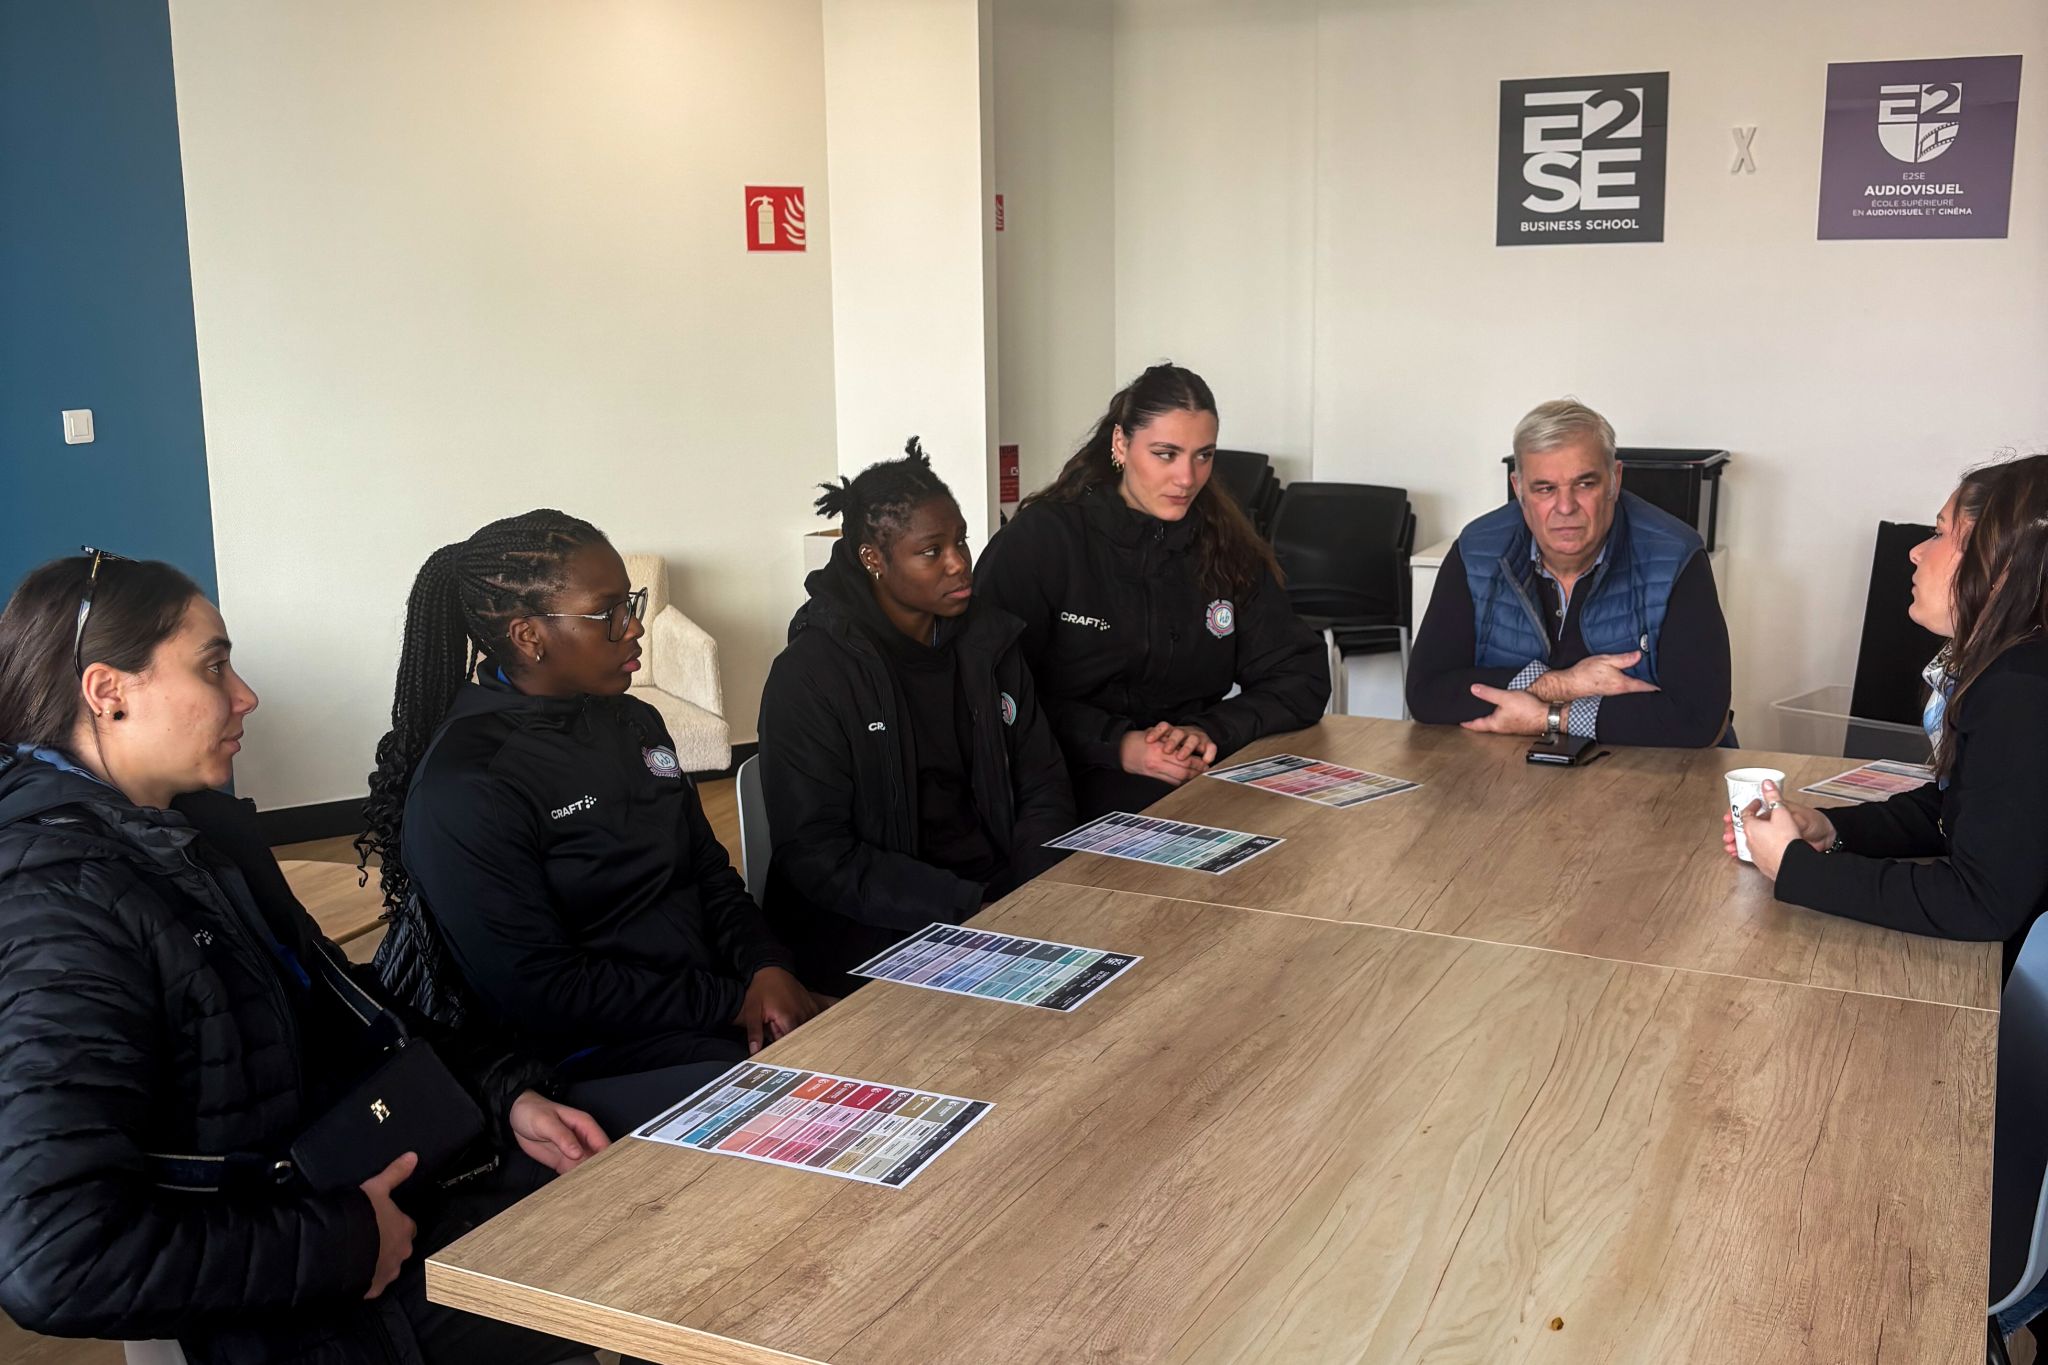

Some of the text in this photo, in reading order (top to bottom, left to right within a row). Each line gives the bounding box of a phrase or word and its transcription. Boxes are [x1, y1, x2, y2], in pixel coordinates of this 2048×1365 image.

[1730, 126, 1758, 175] X
[1902, 172, 1926, 181] E2SE
[1864, 183, 1964, 196] AUDIOVISUEL
[1871, 198, 1954, 208] ÉCOLE SUPÉRIEURE
[1852, 206, 1973, 217] EN AUDIOVISUEL ET CINÉMA
[1520, 218, 1639, 232] BUSINESS SCHOOL
[1060, 611, 1101, 628] CRAFT
[550, 799, 584, 820] CRAFT
